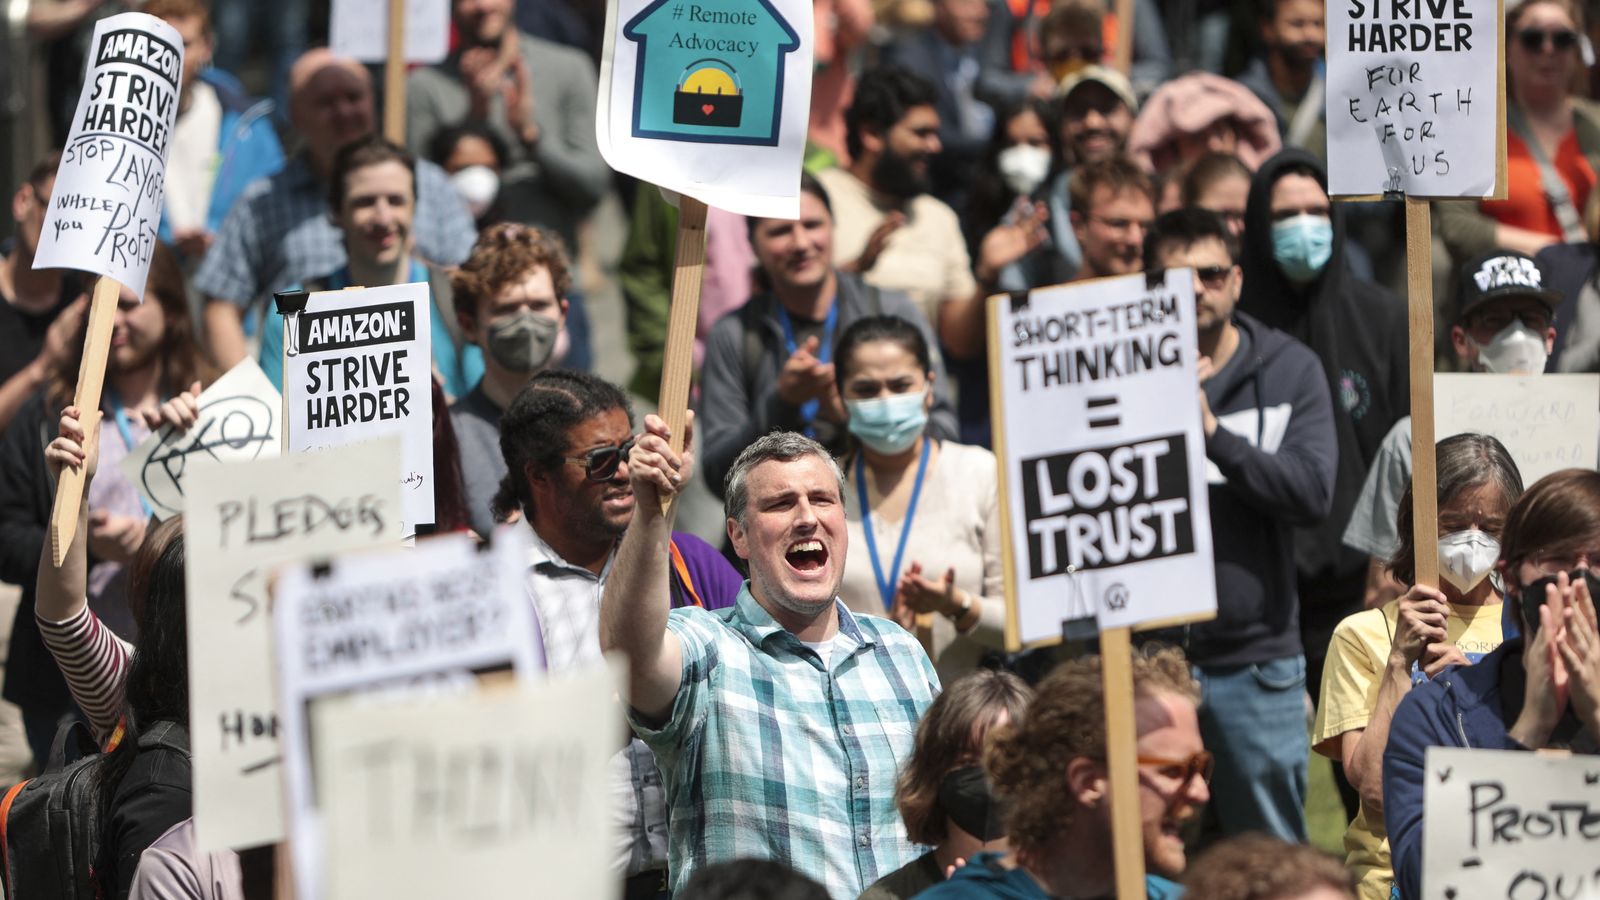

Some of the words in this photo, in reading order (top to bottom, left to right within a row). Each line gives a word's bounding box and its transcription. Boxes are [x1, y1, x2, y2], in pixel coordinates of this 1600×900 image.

[689, 5, 757, 25] Remote
[1348, 0, 1473, 19] STRIVE
[668, 32, 759, 57] Advocacy
[1348, 23, 1473, 52] HARDER
[101, 33, 180, 83] AMAZON
[1366, 62, 1423, 92] FOR
[91, 71, 174, 127] STRIVE
[1349, 87, 1472, 123] EARTH
[82, 103, 168, 155] HARDER
[1381, 121, 1435, 144] FOR
[66, 137, 114, 166] STOP
[1412, 151, 1449, 176] US
[57, 194, 112, 212] WHILE
[307, 309, 407, 346] AMAZON:
[1013, 294, 1181, 348] SHORT-TERM
[306, 350, 410, 394] STRIVE
[1015, 332, 1182, 391] THINKING
[307, 388, 410, 430] HARDER
[1036, 439, 1170, 516] LOST
[1029, 497, 1189, 574] TRUST
